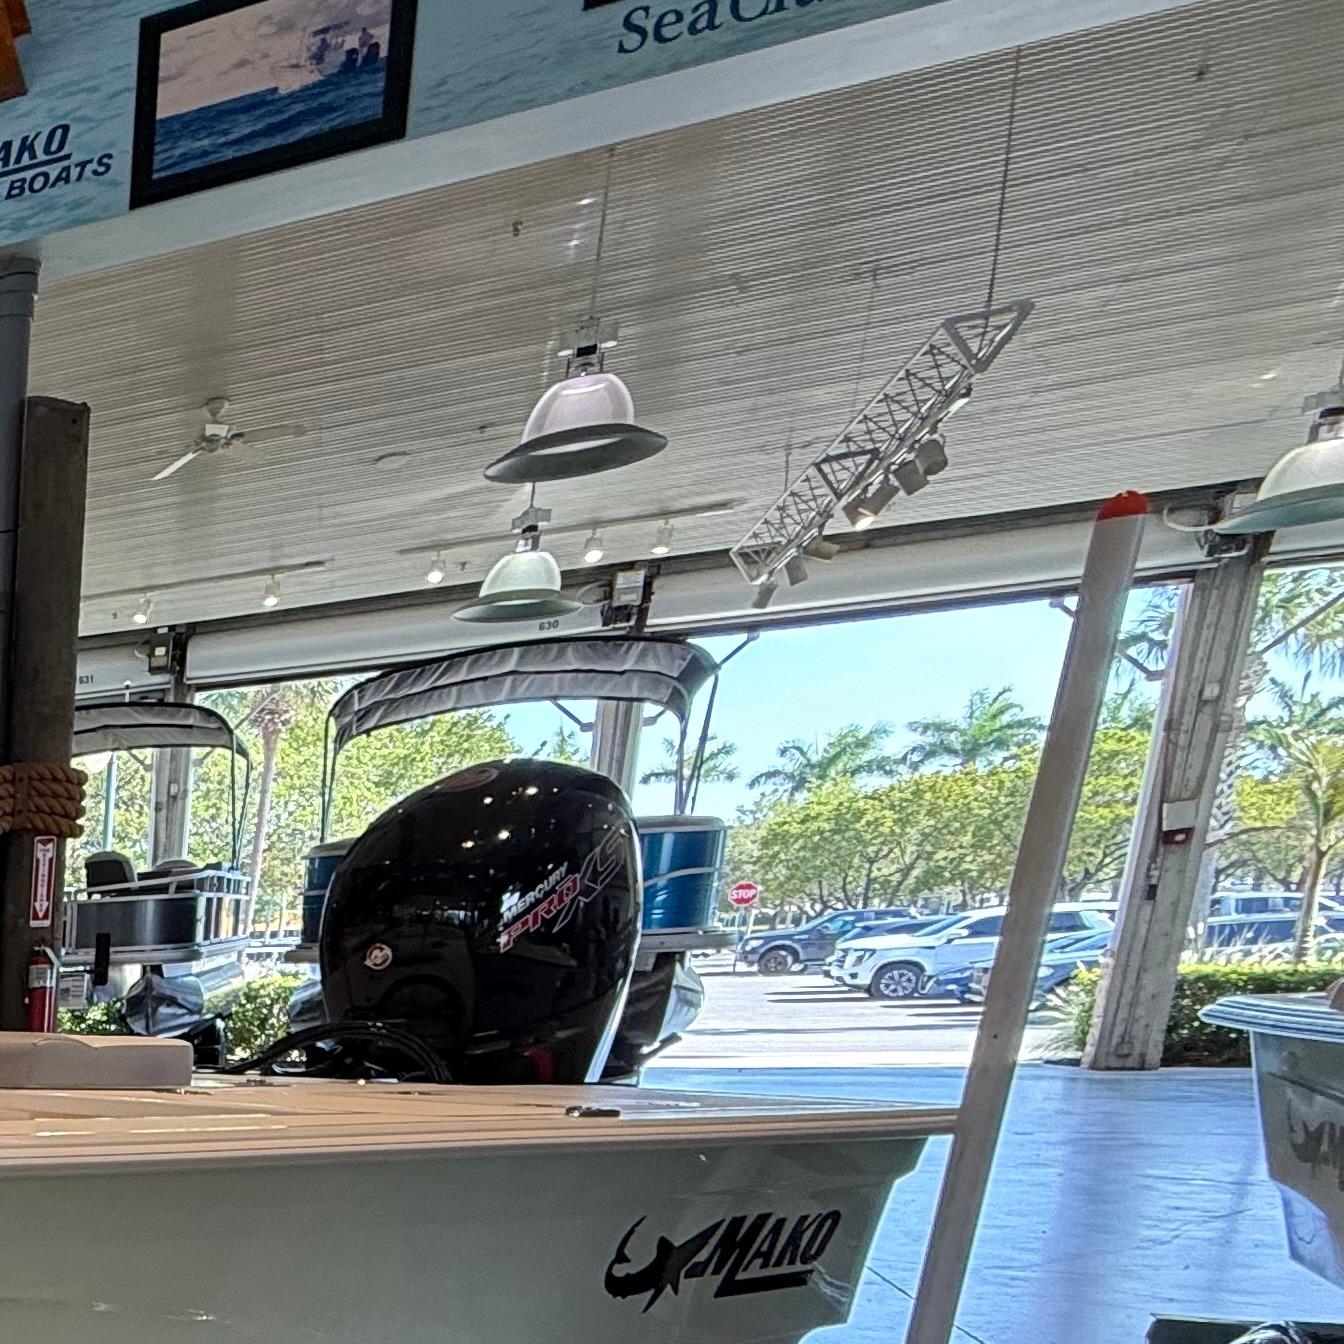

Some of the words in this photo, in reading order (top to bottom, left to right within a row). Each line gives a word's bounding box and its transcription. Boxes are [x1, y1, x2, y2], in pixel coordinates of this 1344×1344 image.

[4, 153, 114, 201] BOATS
[538, 619, 560, 632] 630
[502, 860, 569, 924] MERCURY
[730, 889, 757, 900] STOP
[683, 1209, 842, 1299] MAKO
